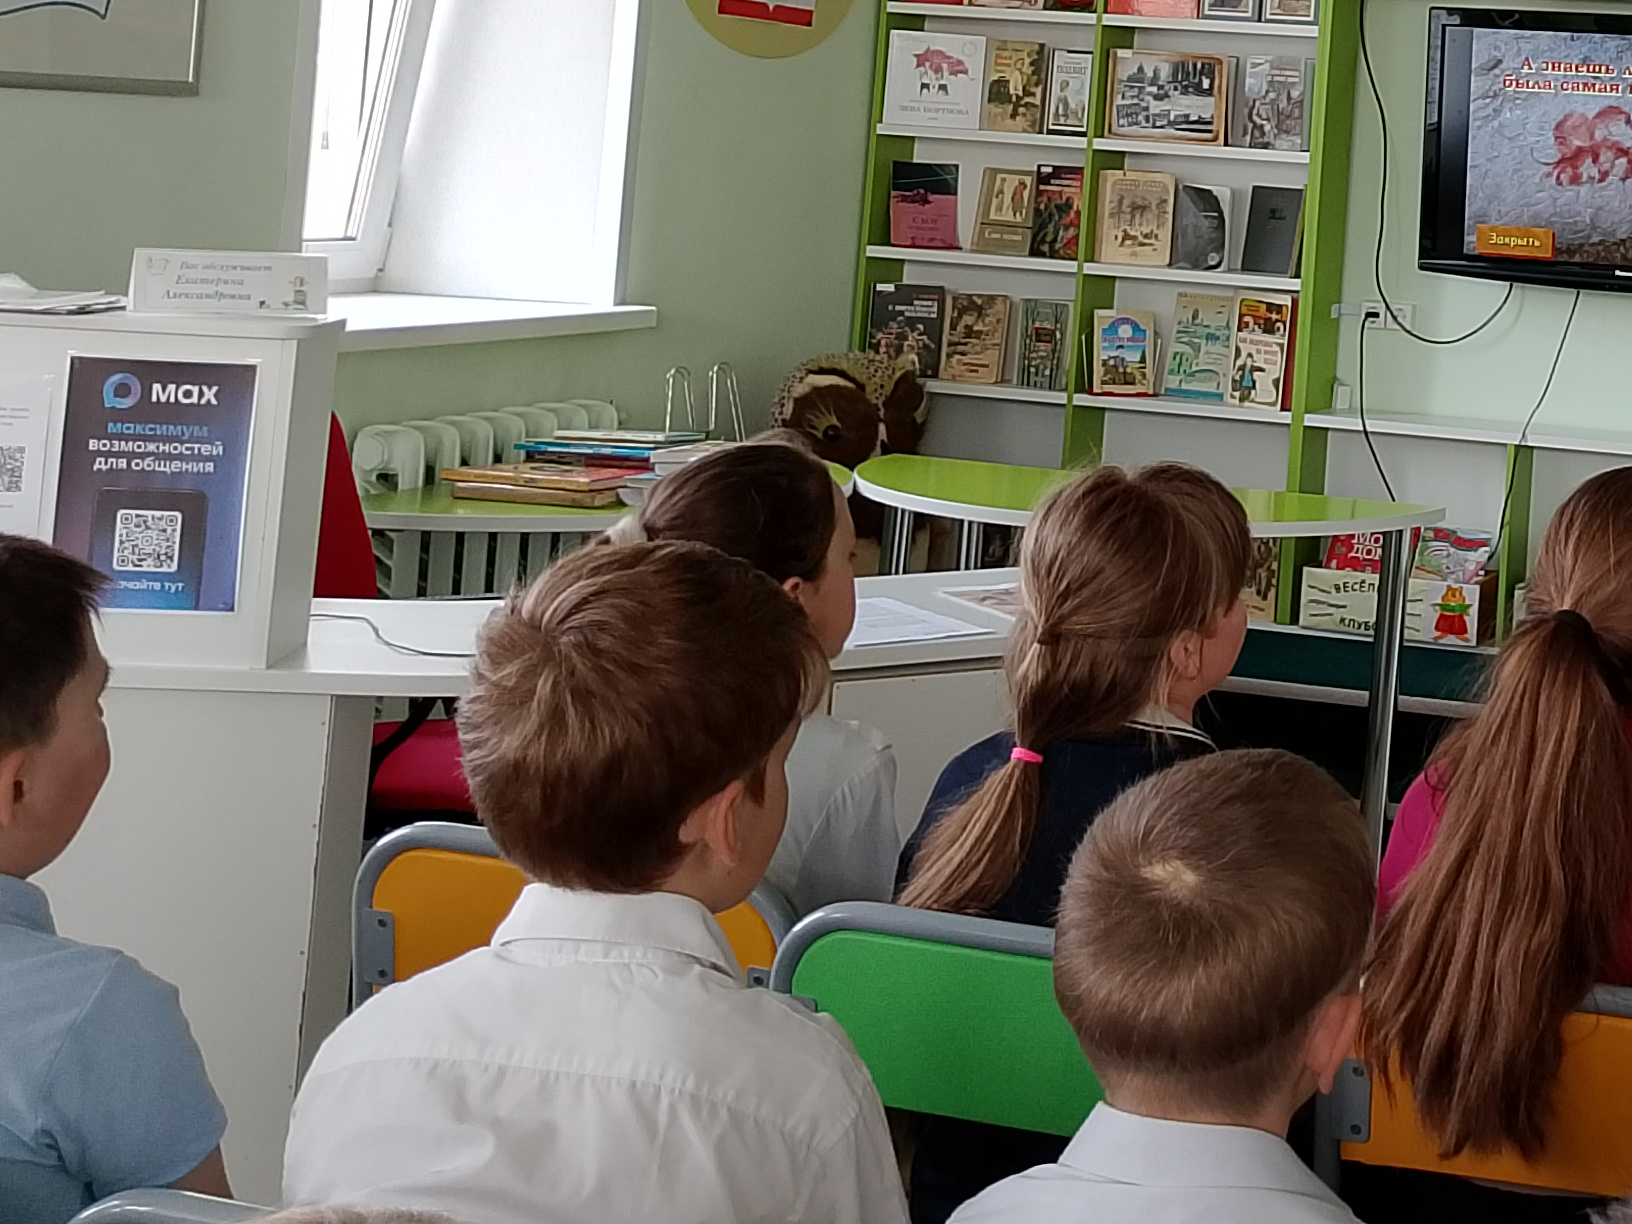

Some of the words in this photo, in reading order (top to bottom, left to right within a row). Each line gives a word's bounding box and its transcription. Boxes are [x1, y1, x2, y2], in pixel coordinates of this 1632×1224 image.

[1521, 57, 1535, 73] А
[1542, 60, 1616, 76] знаешь
[1503, 74, 1554, 92] была
[1560, 79, 1622, 96] самая
[1488, 232, 1541, 247] Закрыть
[175, 274, 245, 288] Екатерина
[162, 289, 252, 302] Александровна
[107, 422, 209, 440] максимум
[88, 438, 224, 456] возможностей
[93, 456, 127, 472] для
[131, 456, 215, 475] общения
[164, 581, 185, 593] тут
